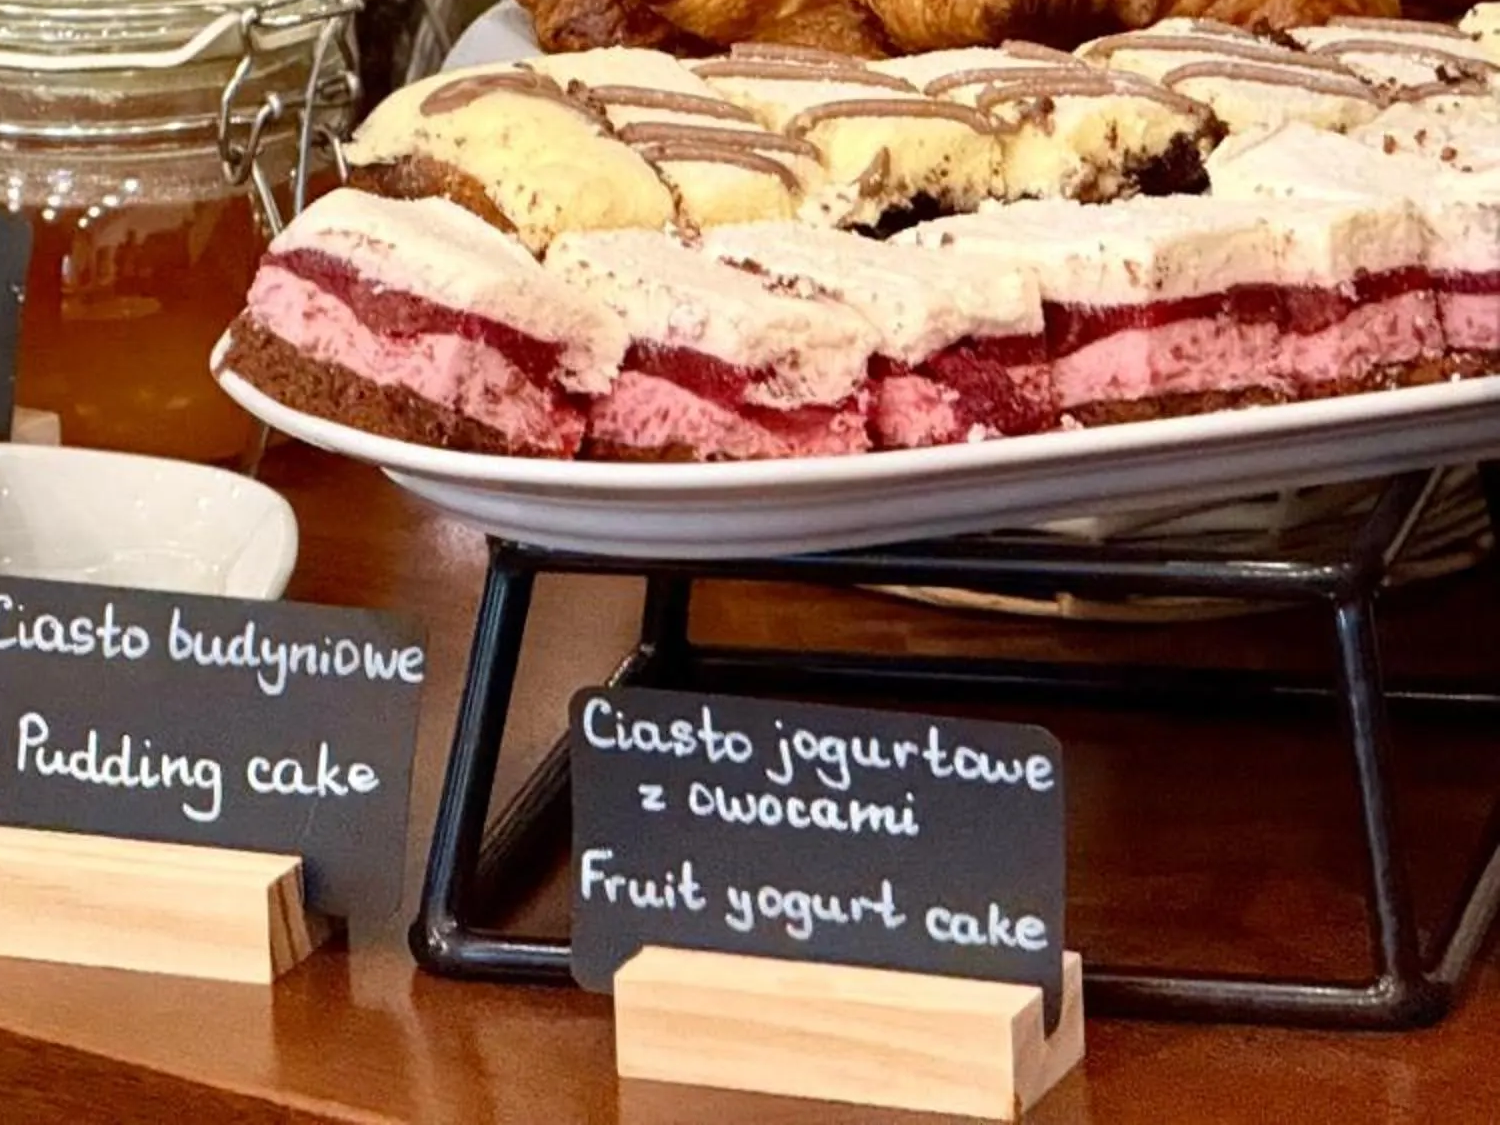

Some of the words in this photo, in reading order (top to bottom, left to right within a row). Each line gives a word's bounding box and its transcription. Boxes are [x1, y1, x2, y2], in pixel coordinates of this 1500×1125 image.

[168, 607, 425, 696] budyniowe
[16, 712, 222, 822] Pudding
[247, 741, 380, 797] cake
[582, 697, 752, 763] Ciasto
[765, 720, 1055, 792] jogurtowe
[638, 783, 667, 813] z
[688, 781, 920, 837] owocami
[580, 848, 707, 911] Fruit
[724, 878, 906, 941] yogurt
[925, 903, 1048, 952] cake
